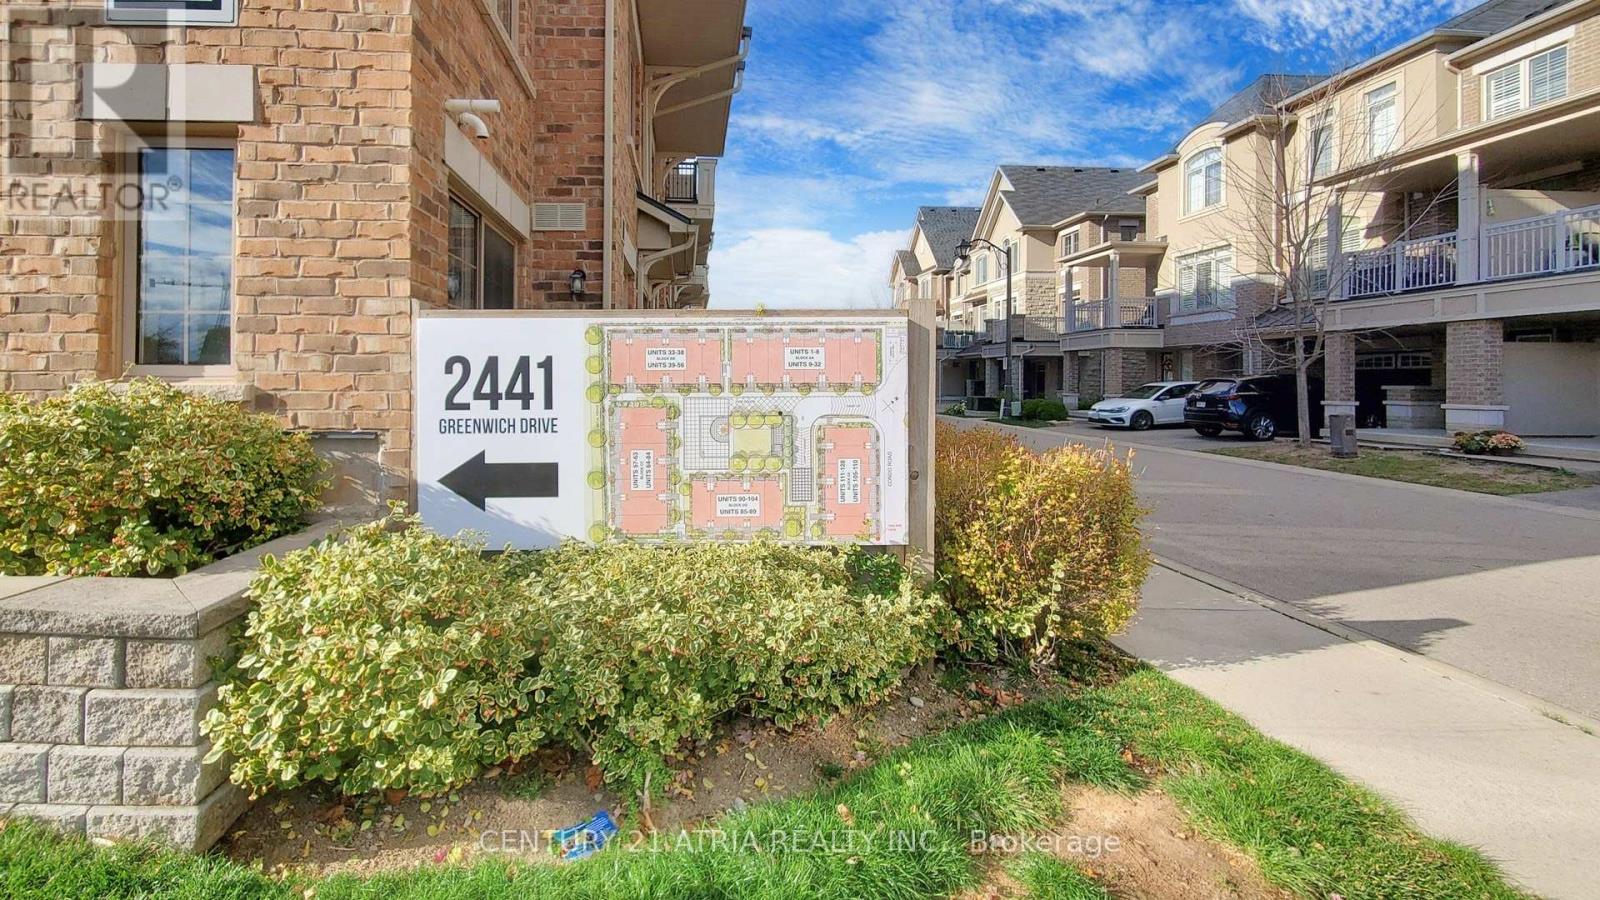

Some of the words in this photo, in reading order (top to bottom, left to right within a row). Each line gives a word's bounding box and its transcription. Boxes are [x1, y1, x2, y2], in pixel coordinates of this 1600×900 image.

[444, 355, 553, 410] 2441
[439, 418, 516, 434] GREENWICH
[520, 418, 558, 434] DRIVE
